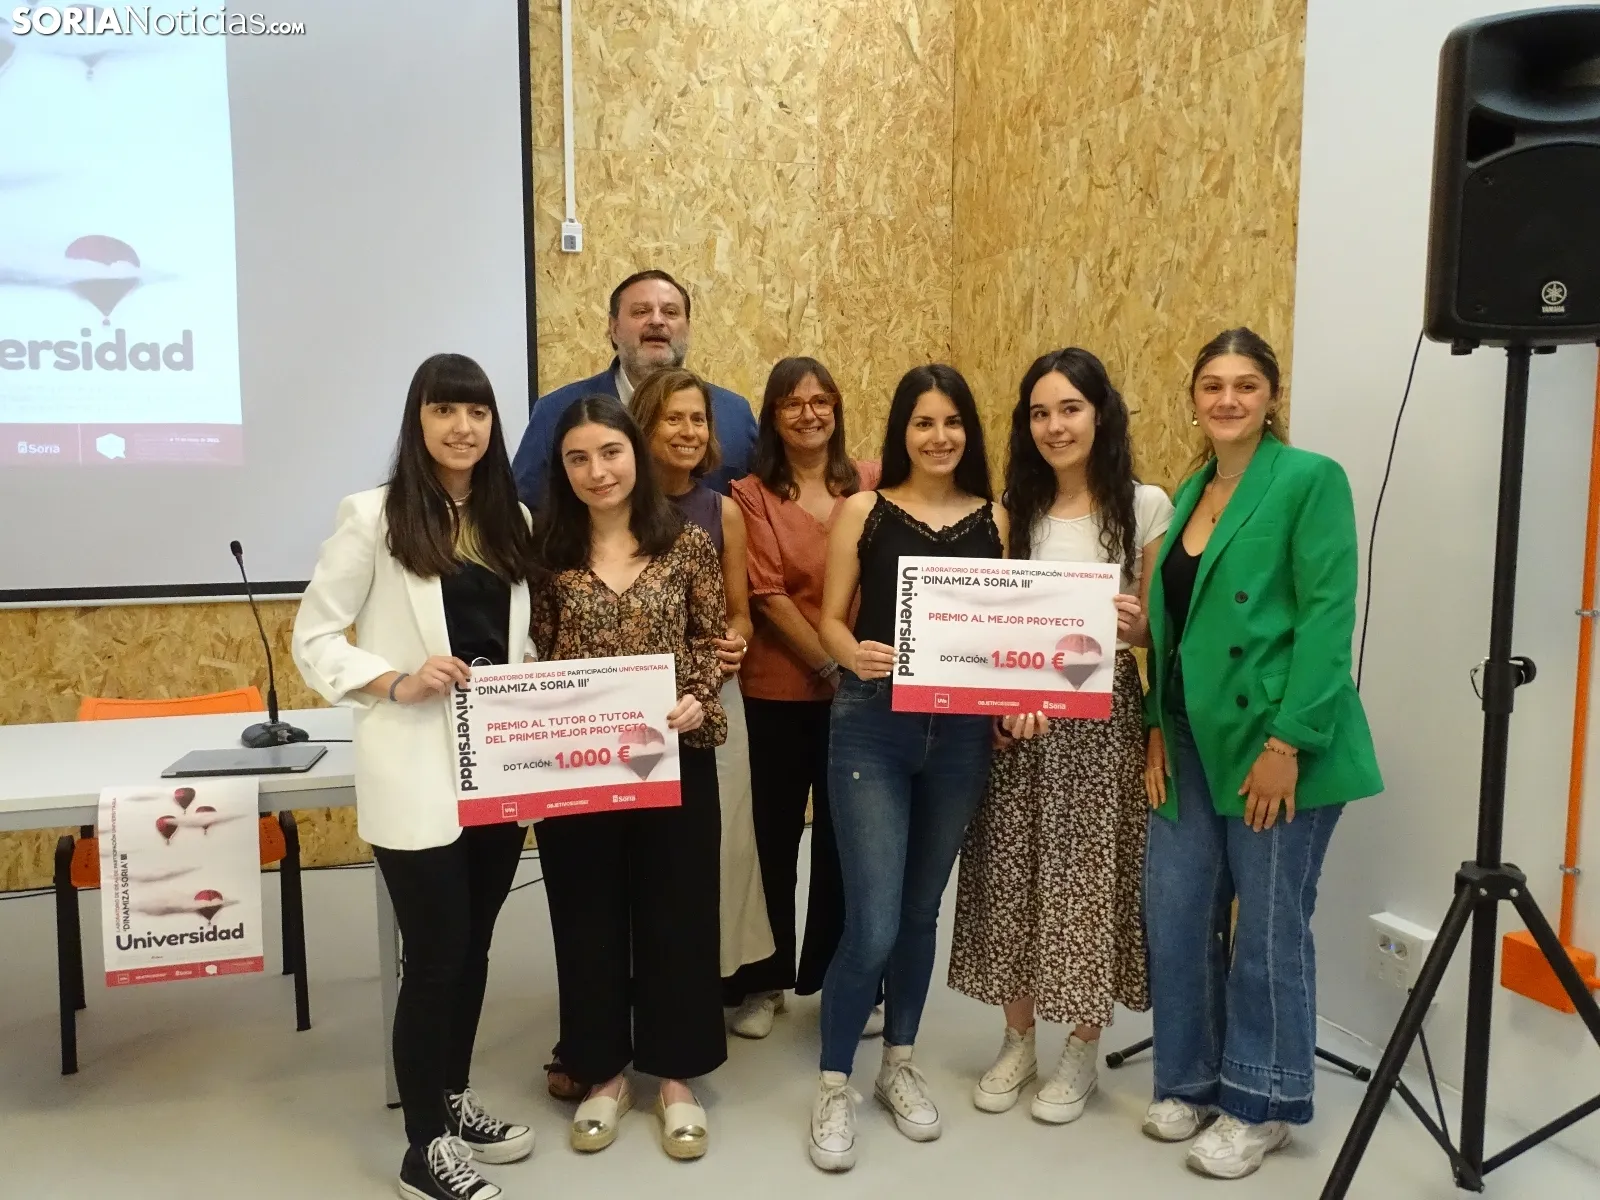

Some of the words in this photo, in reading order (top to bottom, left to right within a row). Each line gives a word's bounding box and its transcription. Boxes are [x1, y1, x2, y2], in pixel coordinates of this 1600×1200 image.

[28, 444, 60, 454] Soria
[921, 566, 968, 574] LABORATORIO
[1011, 569, 1062, 578] PARTICIPACIÓN
[1064, 572, 1114, 580] UNIVERSITARIA
[984, 577, 1018, 588] SORIA
[898, 566, 918, 676] Universidad
[928, 612, 968, 622] PREMIO
[970, 614, 984, 623] AL
[988, 614, 1024, 625] MEJOR
[1026, 616, 1084, 628] PROYECTO
[940, 654, 988, 664] DOTACIÓN:
[991, 650, 1044, 670] 1.500
[1052, 652, 1066, 671] €
[474, 674, 524, 683] LABORATORIO
[568, 667, 618, 676] PARTICIPACIÓN
[619, 664, 669, 672] UNIVERSITARIA
[540, 680, 576, 691] SORIA
[1049, 702, 1066, 710] Soria
[487, 720, 528, 732] PREMIO
[532, 719, 545, 728] AL
[548, 715, 586, 726] TUTOR
[588, 714, 596, 723] O
[600, 711, 644, 722] TUTORA
[486, 735, 506, 744] DEL
[509, 731, 548, 742] PRIMER
[551, 728, 587, 739] MEJOR
[590, 723, 648, 735] PROYECTO
[504, 758, 552, 772] DOTACIÓN:
[555, 748, 611, 769] 1.000
[617, 745, 632, 763] €
[618, 794, 636, 803] Soria
[116, 923, 244, 950] Universidad
